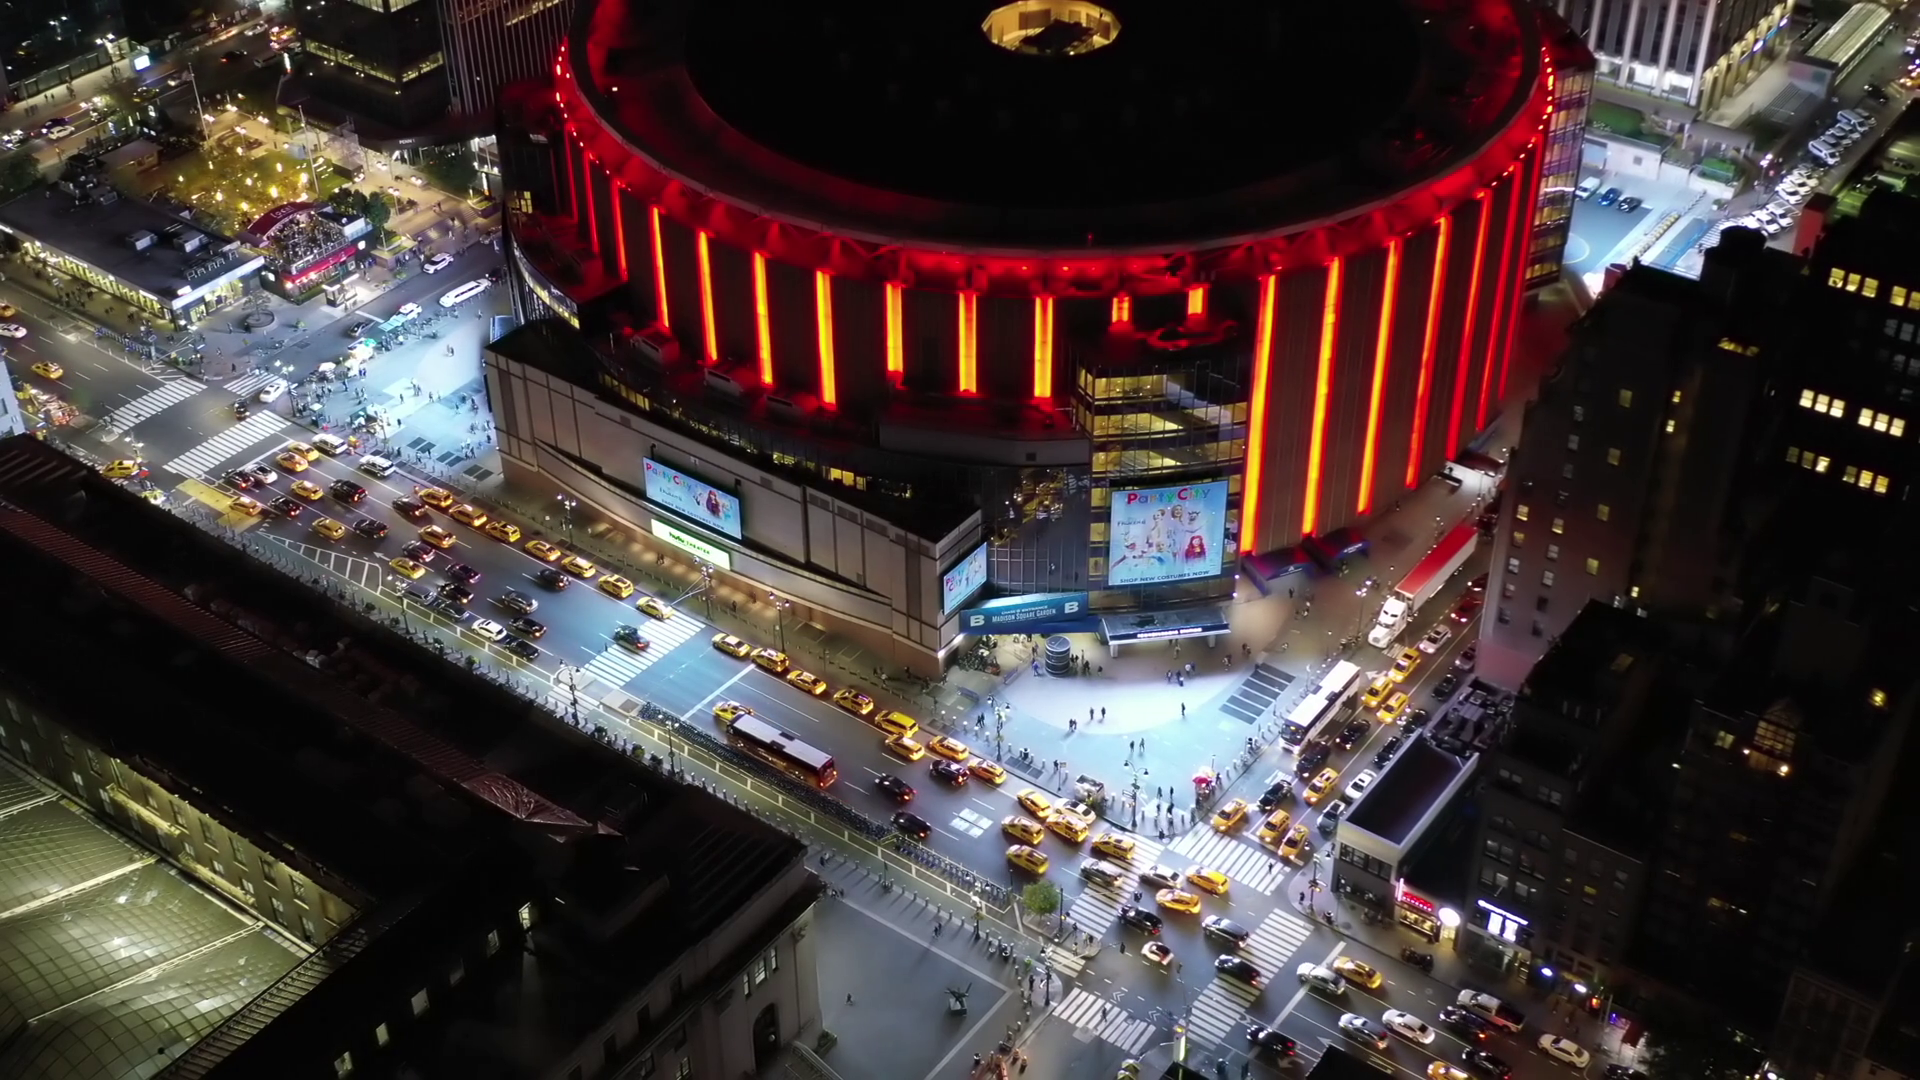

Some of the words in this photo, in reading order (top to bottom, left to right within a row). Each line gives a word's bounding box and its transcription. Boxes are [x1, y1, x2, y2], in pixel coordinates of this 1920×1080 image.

[1157, 572, 1191, 580] COSTUMES
[1064, 601, 1079, 614] B
[969, 615, 985, 627] B
[992, 614, 1015, 623] MADISON
[1016, 611, 1036, 620] SQUARE
[1036, 608, 1056, 617] GARDEN
